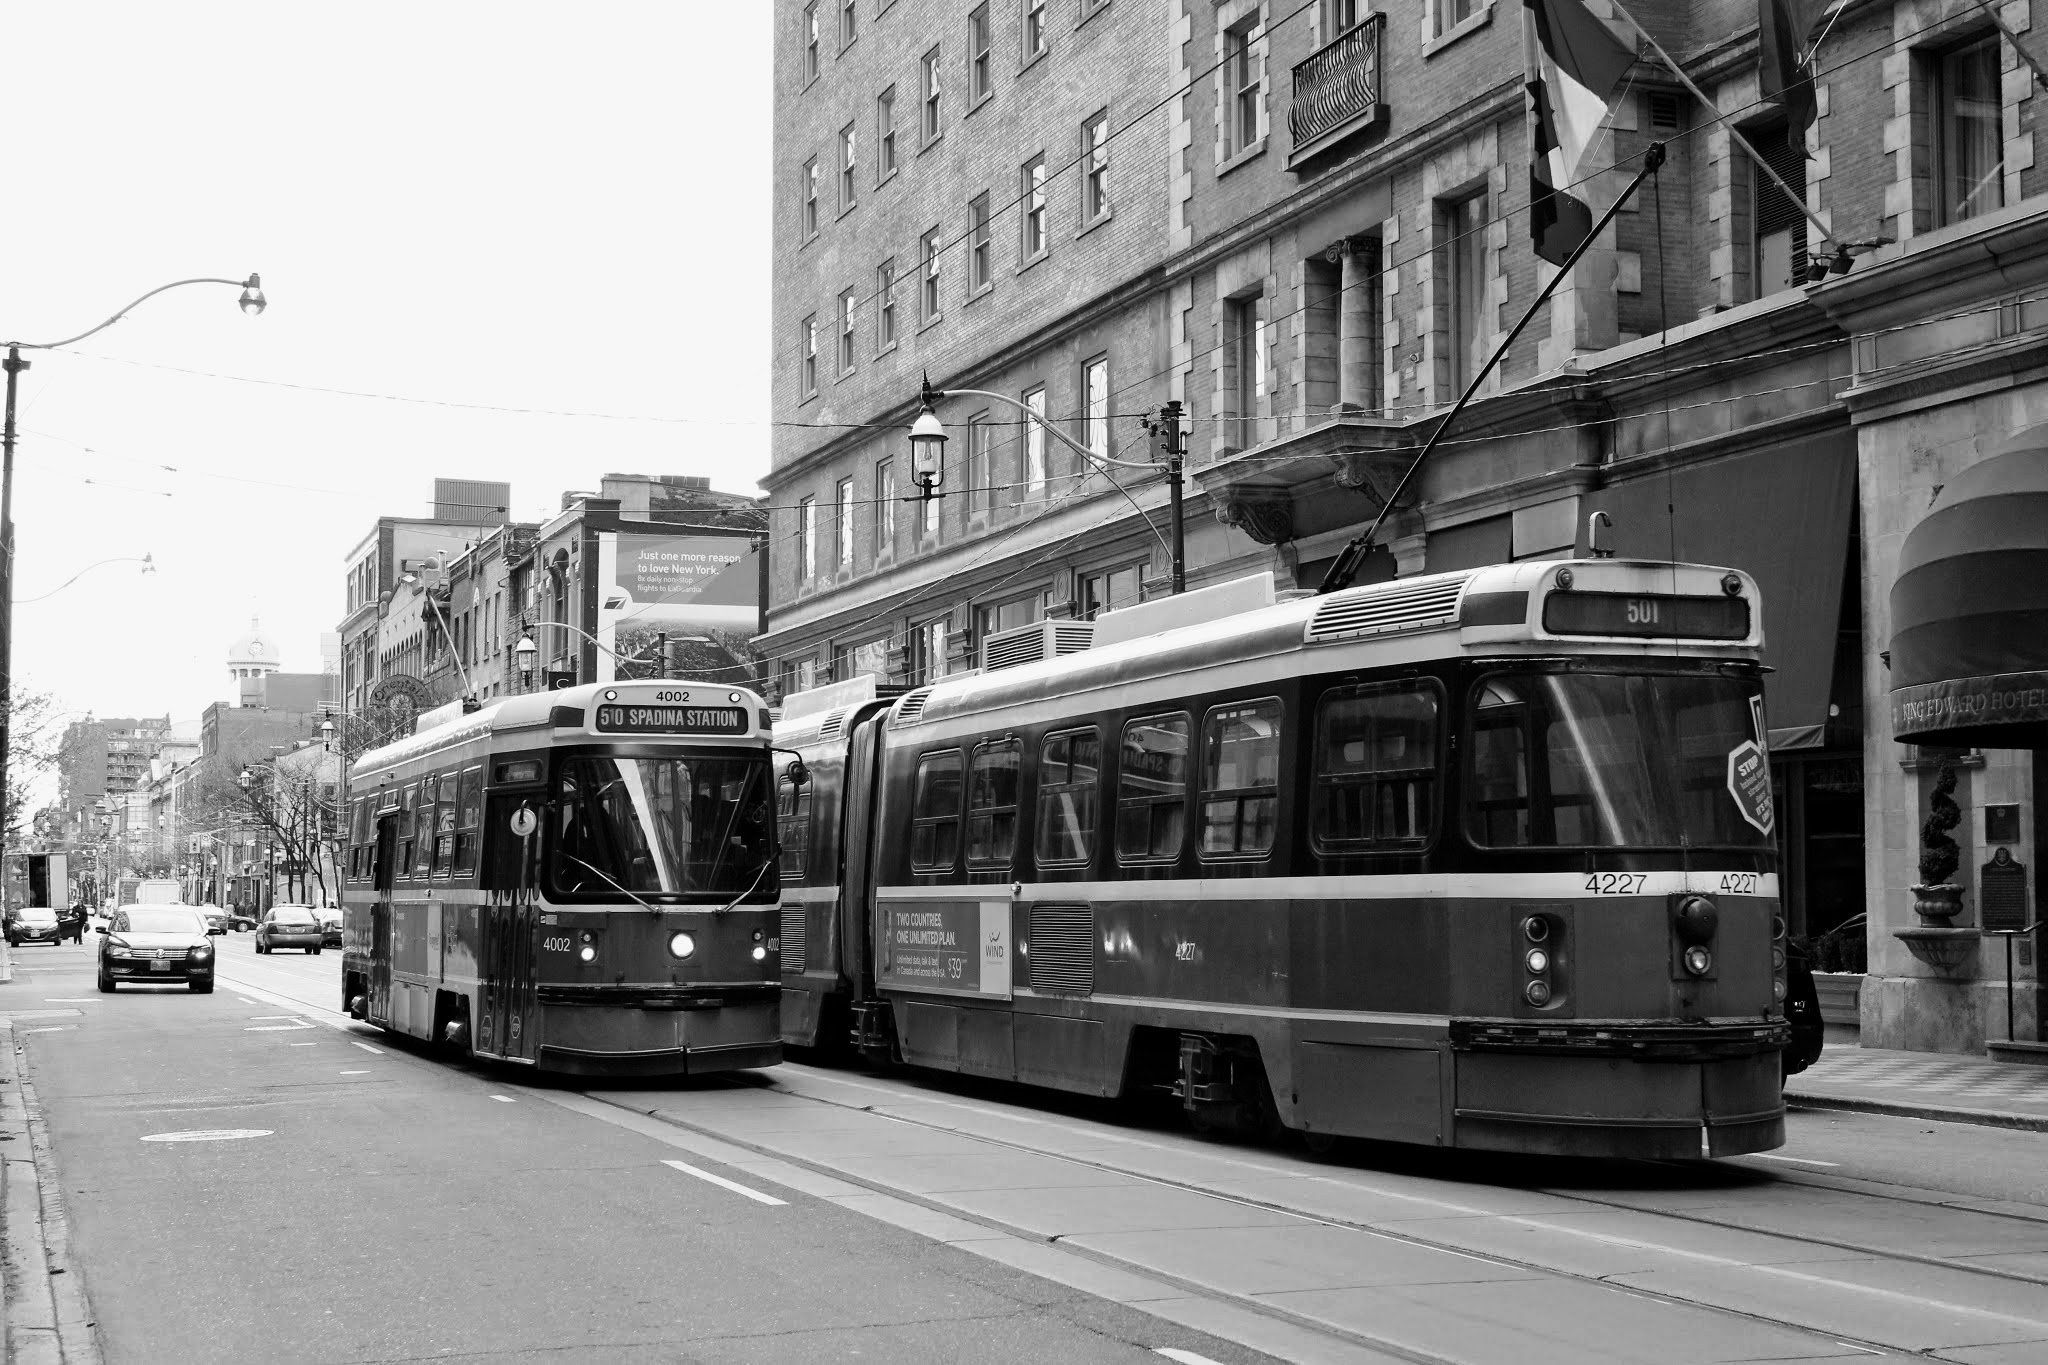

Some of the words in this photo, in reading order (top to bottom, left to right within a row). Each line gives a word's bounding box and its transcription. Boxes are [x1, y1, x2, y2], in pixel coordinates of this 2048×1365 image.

[638, 550, 659, 560] Just
[660, 552, 679, 561] one
[681, 553, 707, 562] more
[708, 554, 741, 563] reason
[638, 564, 647, 573] to
[649, 563, 670, 573] love
[671, 564, 693, 574] New
[695, 565, 719, 575] York.
[646, 575, 662, 584] daily
[663, 576, 693, 585] non-stop
[637, 584, 659, 593] flights
[1627, 599, 1659, 624] 501
[655, 691, 690, 702] 4002
[1902, 701, 1924, 722] KING
[1927, 693, 1987, 717] EDWARD
[600, 708, 624, 725] 510
[629, 708, 684, 727] SPADINA
[686, 709, 738, 727] STATION
[1737, 754, 1759, 777] STOP
[1585, 873, 1647, 894] 4227
[1720, 873, 1757, 894] 4227
[897, 912, 910, 927] TWO
[910, 912, 943, 929] COUNTRIES,
[543, 936, 571, 952] 4002
[767, 937, 780, 951] 4002
[896, 930, 909, 944] ONE
[909, 930, 939, 945] UNLIMITED
[939, 931, 956, 946] PLAN.
[985, 945, 1004, 958] WIND
[1175, 941, 1196, 961] 4227
[947, 957, 962, 979] $39
